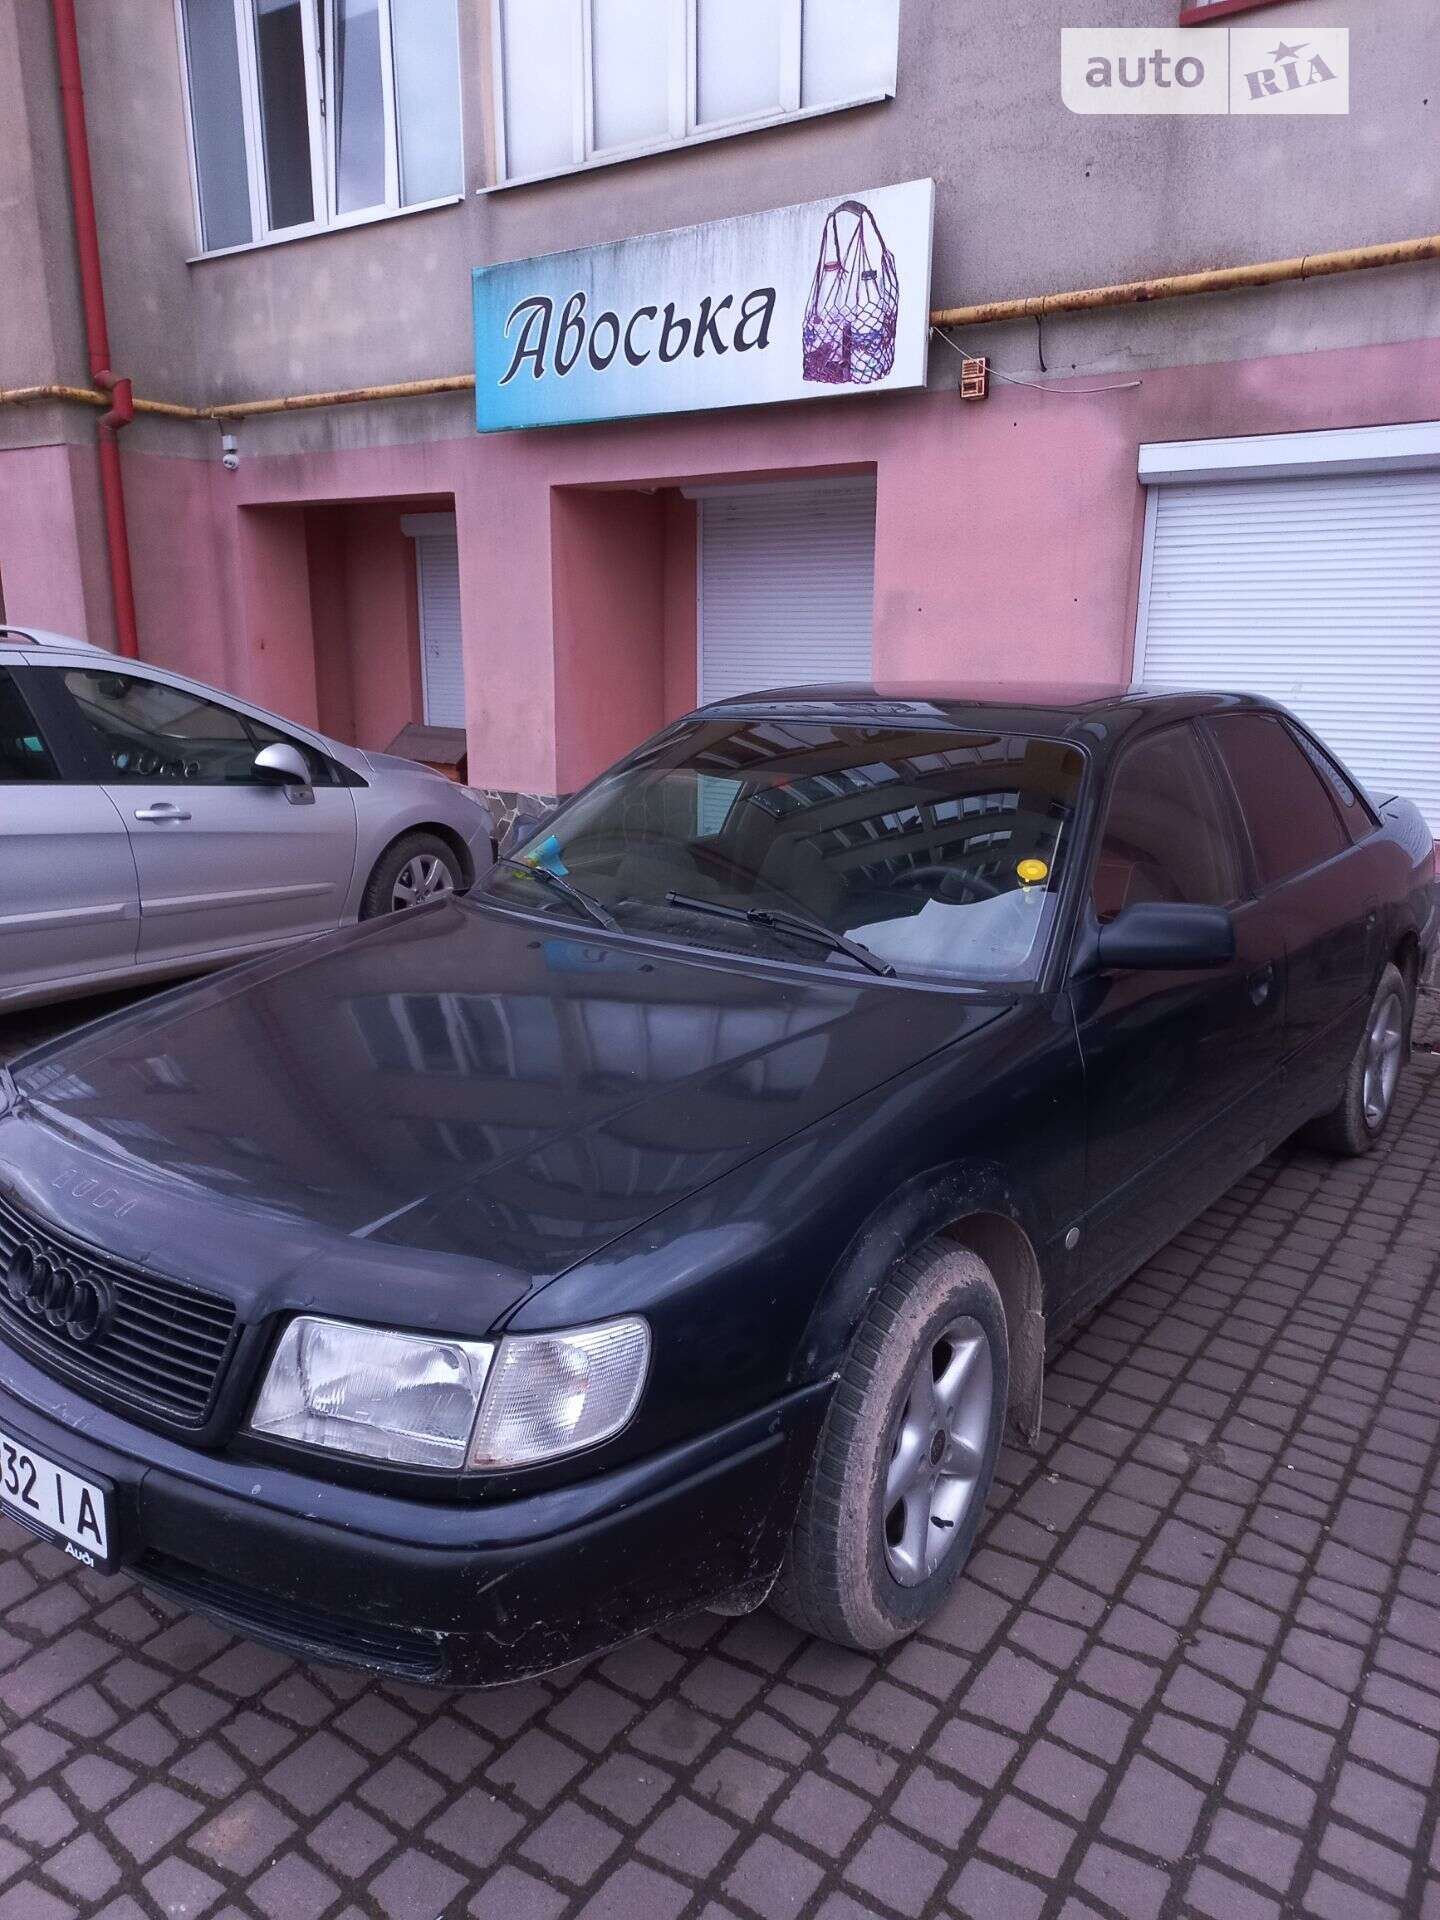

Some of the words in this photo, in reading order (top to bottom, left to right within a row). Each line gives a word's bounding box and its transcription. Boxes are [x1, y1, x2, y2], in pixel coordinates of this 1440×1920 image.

[498, 287, 777, 386] Авоська
[0, 1441, 40, 1510] 32
[56, 1473, 103, 1545] IA
